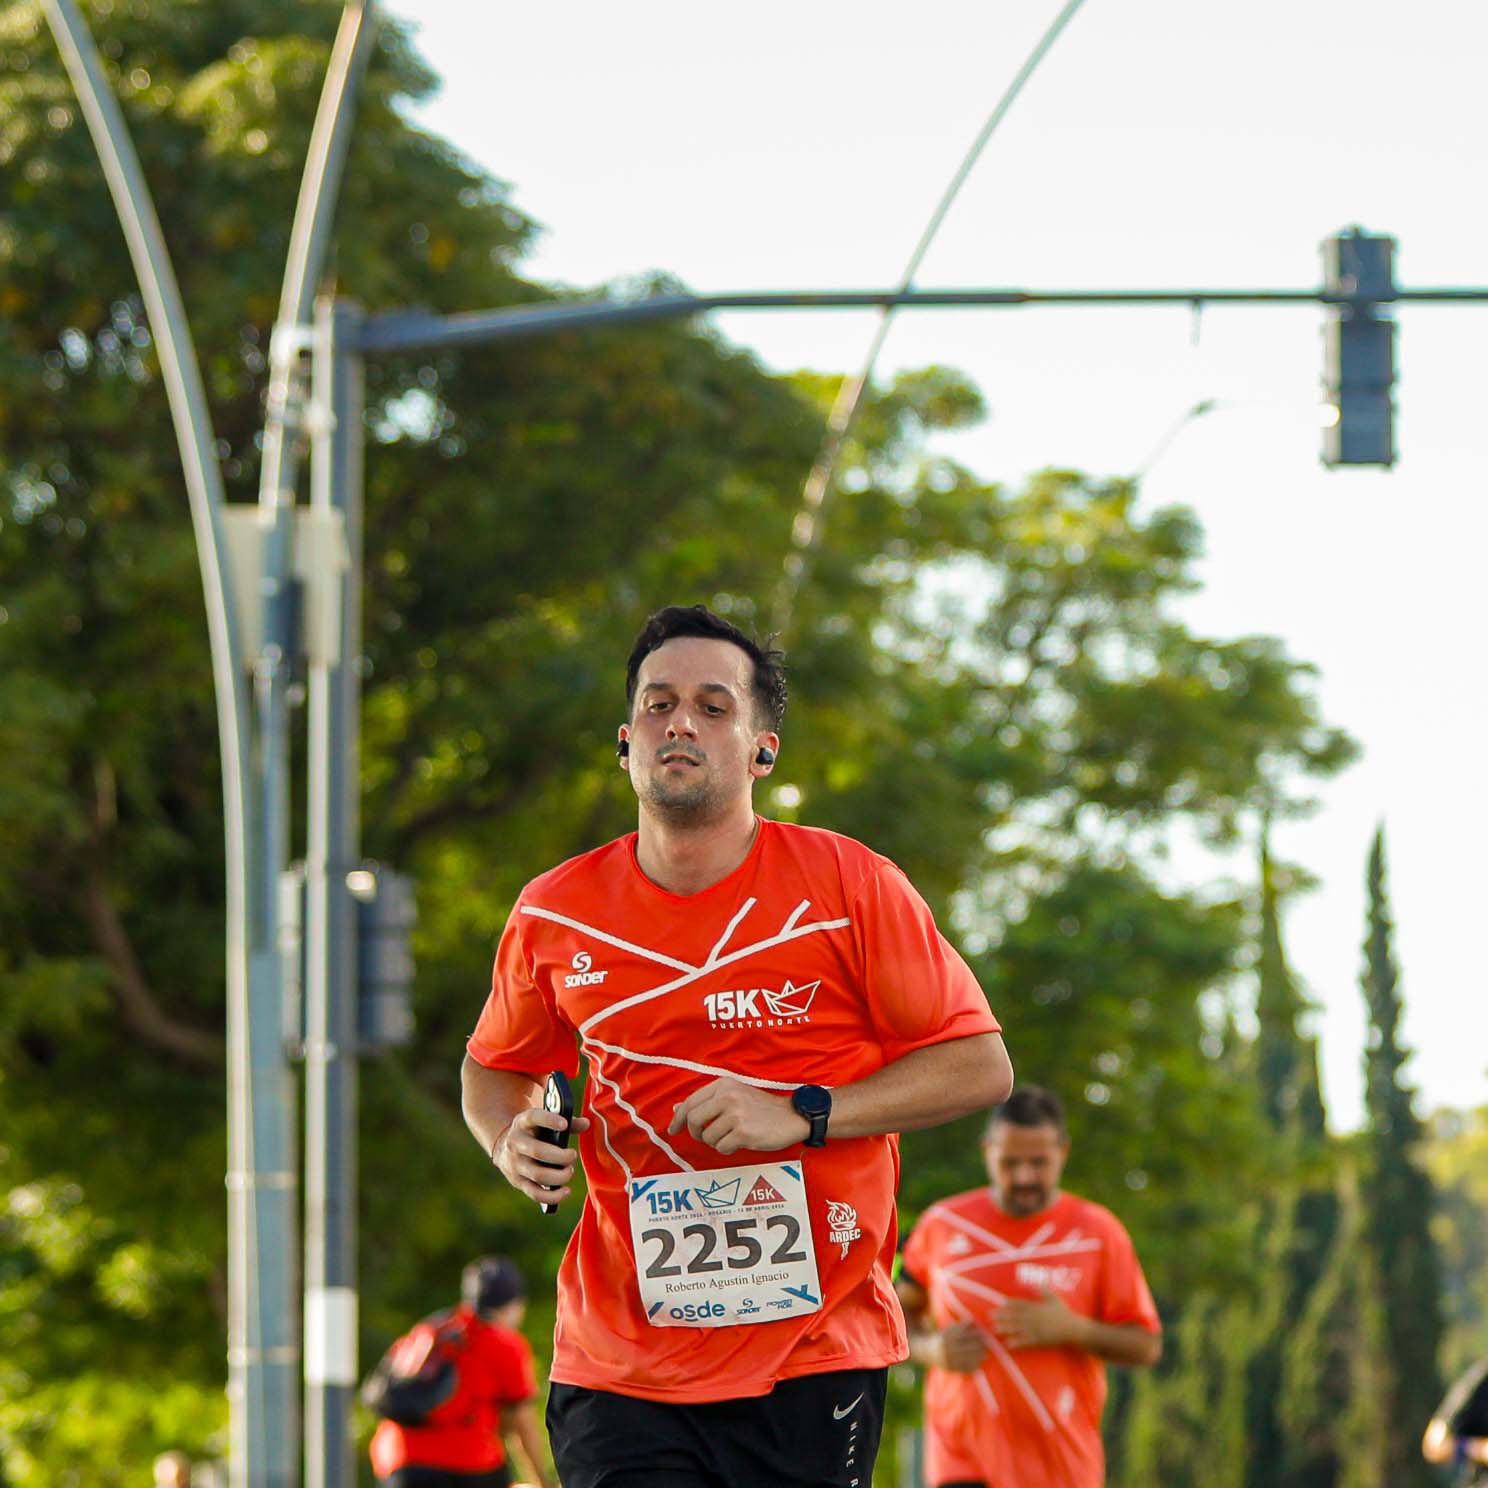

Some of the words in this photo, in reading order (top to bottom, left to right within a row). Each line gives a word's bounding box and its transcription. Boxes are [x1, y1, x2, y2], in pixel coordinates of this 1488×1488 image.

[704, 989, 762, 1021] 15K
[711, 1020, 763, 1030] PUERTO
[767, 1015, 811, 1027] NORTE
[646, 1188, 694, 1214] 15K
[751, 1188, 776, 1201] 15K
[641, 1214, 808, 1279] 2252
[829, 1228, 861, 1243] ARDEC
[665, 1281, 706, 1293] Roberto
[751, 1272, 790, 1286] Ignacio
[669, 1300, 726, 1322] osde
[845, 1421, 858, 1468] NIKE
